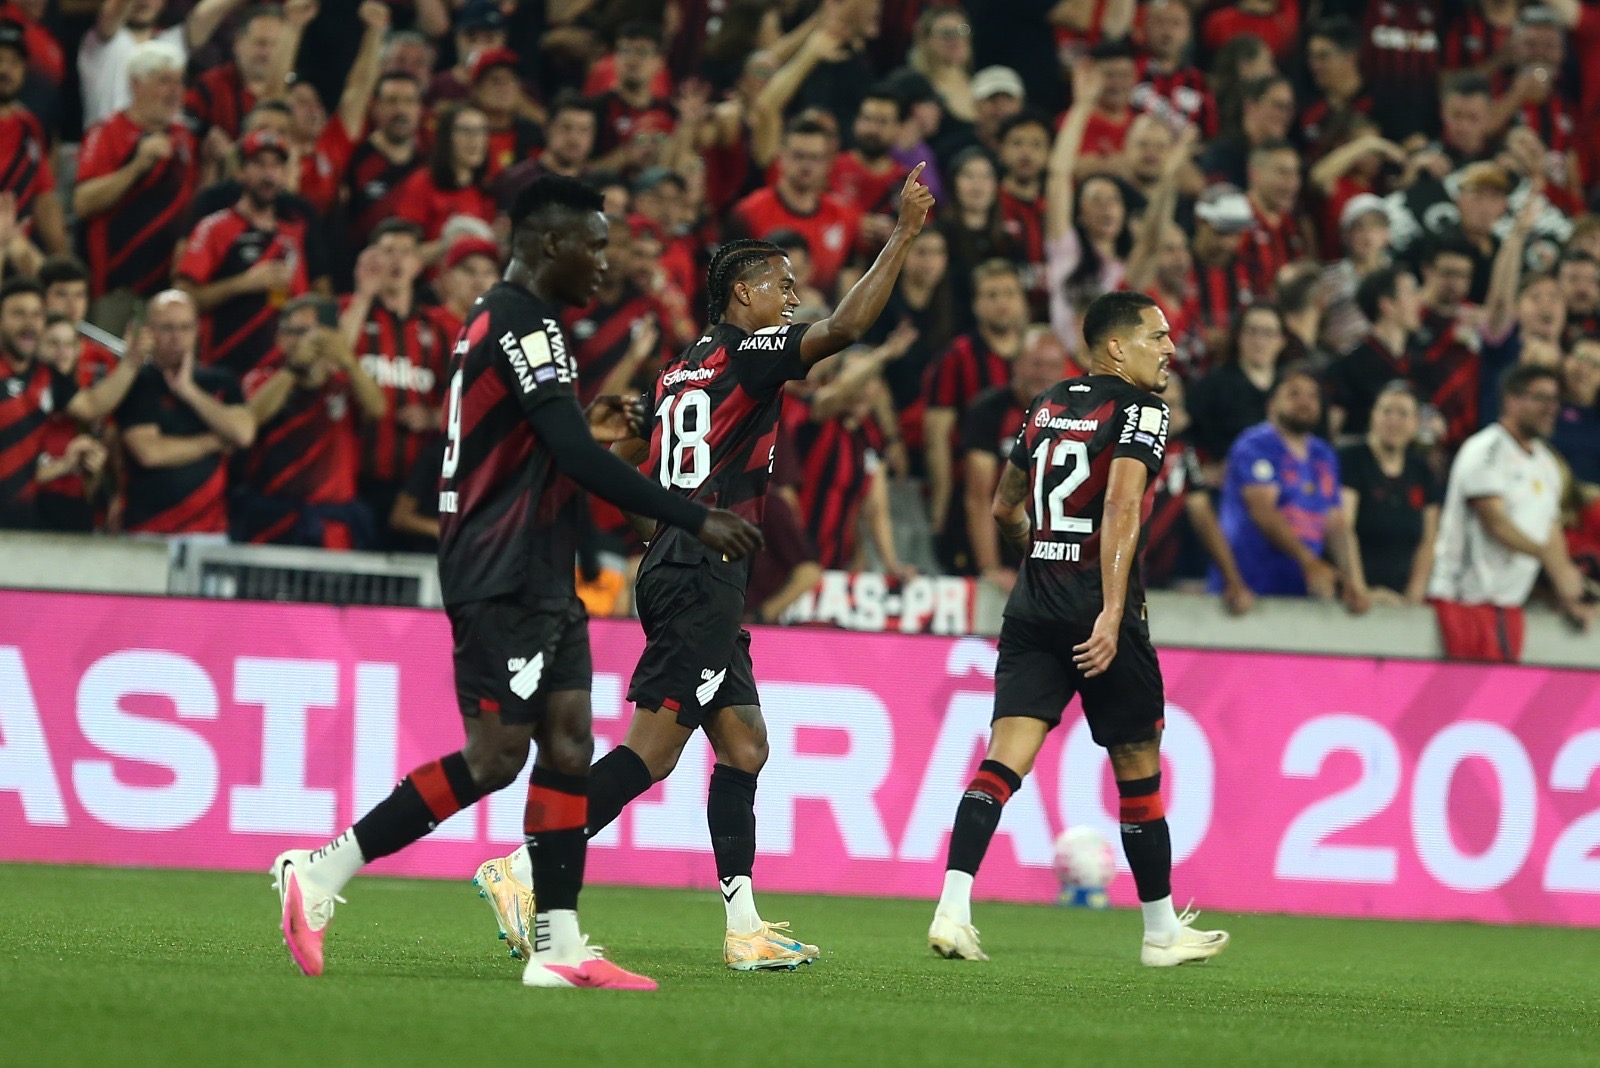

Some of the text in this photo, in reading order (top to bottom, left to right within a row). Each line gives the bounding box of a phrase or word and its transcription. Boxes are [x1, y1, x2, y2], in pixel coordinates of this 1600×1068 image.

[498, 330, 538, 394] HAVAN
[542, 318, 572, 383] HAVAN
[737, 336, 788, 351] HAVAN
[655, 389, 712, 490] 18
[1049, 416, 1099, 431] ADEMICON
[1032, 438, 1093, 533] 12
